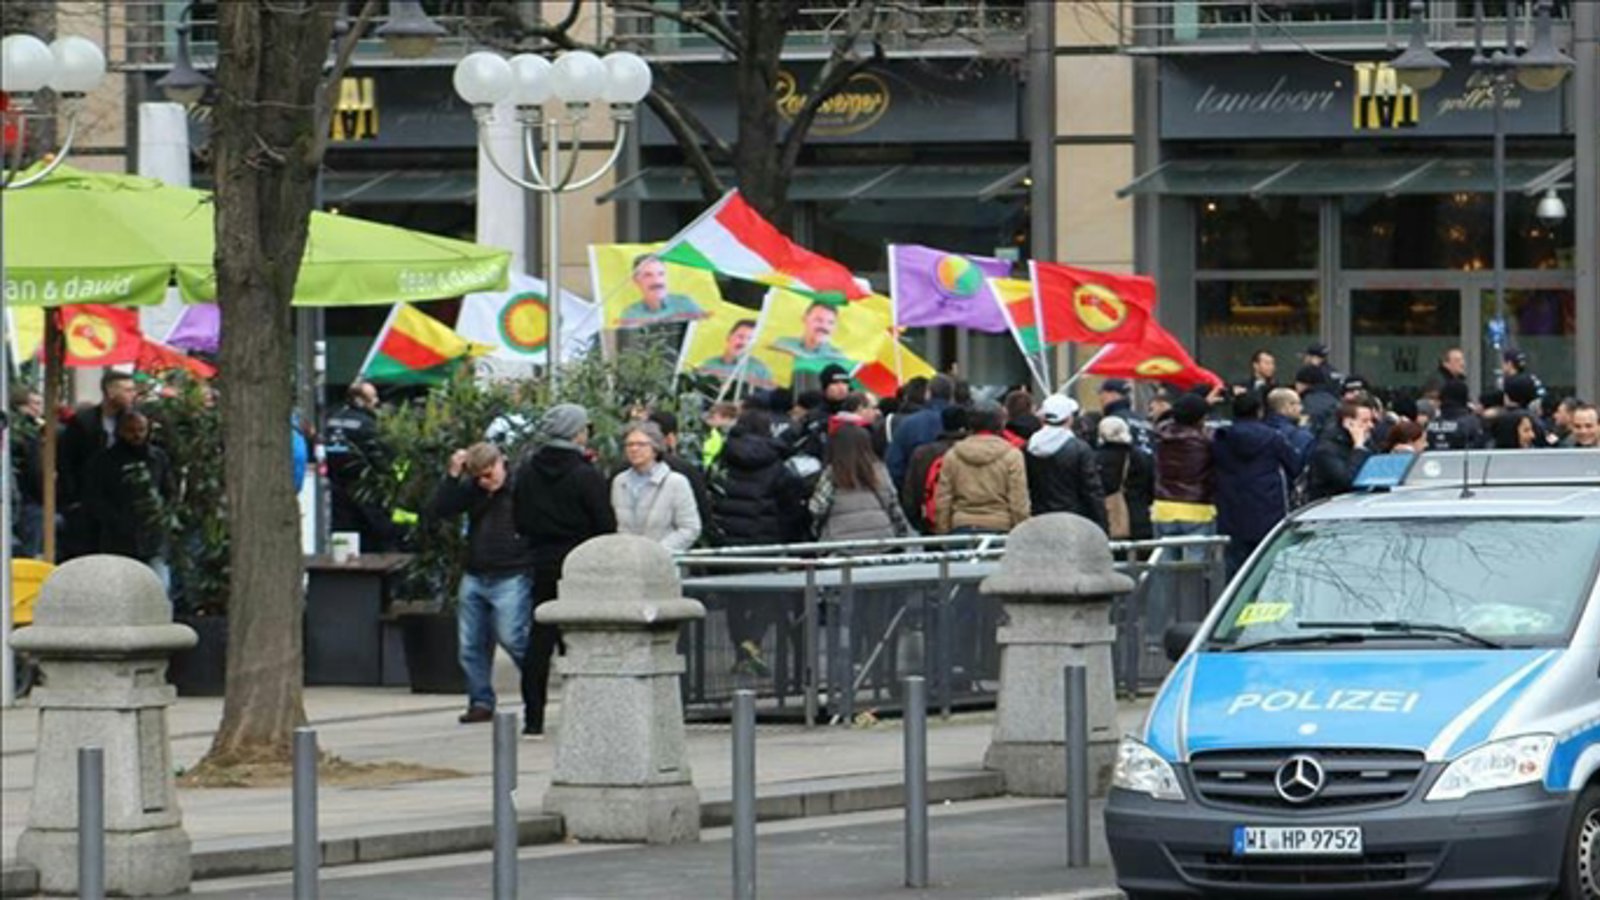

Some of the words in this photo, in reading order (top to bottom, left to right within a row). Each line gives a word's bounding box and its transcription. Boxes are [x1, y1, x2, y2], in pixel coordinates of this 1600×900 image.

[1227, 689, 1420, 716] POLIZEI
[1246, 829, 1267, 849] WI
[1281, 829, 1306, 849] HP
[1311, 829, 1358, 849] 9752
